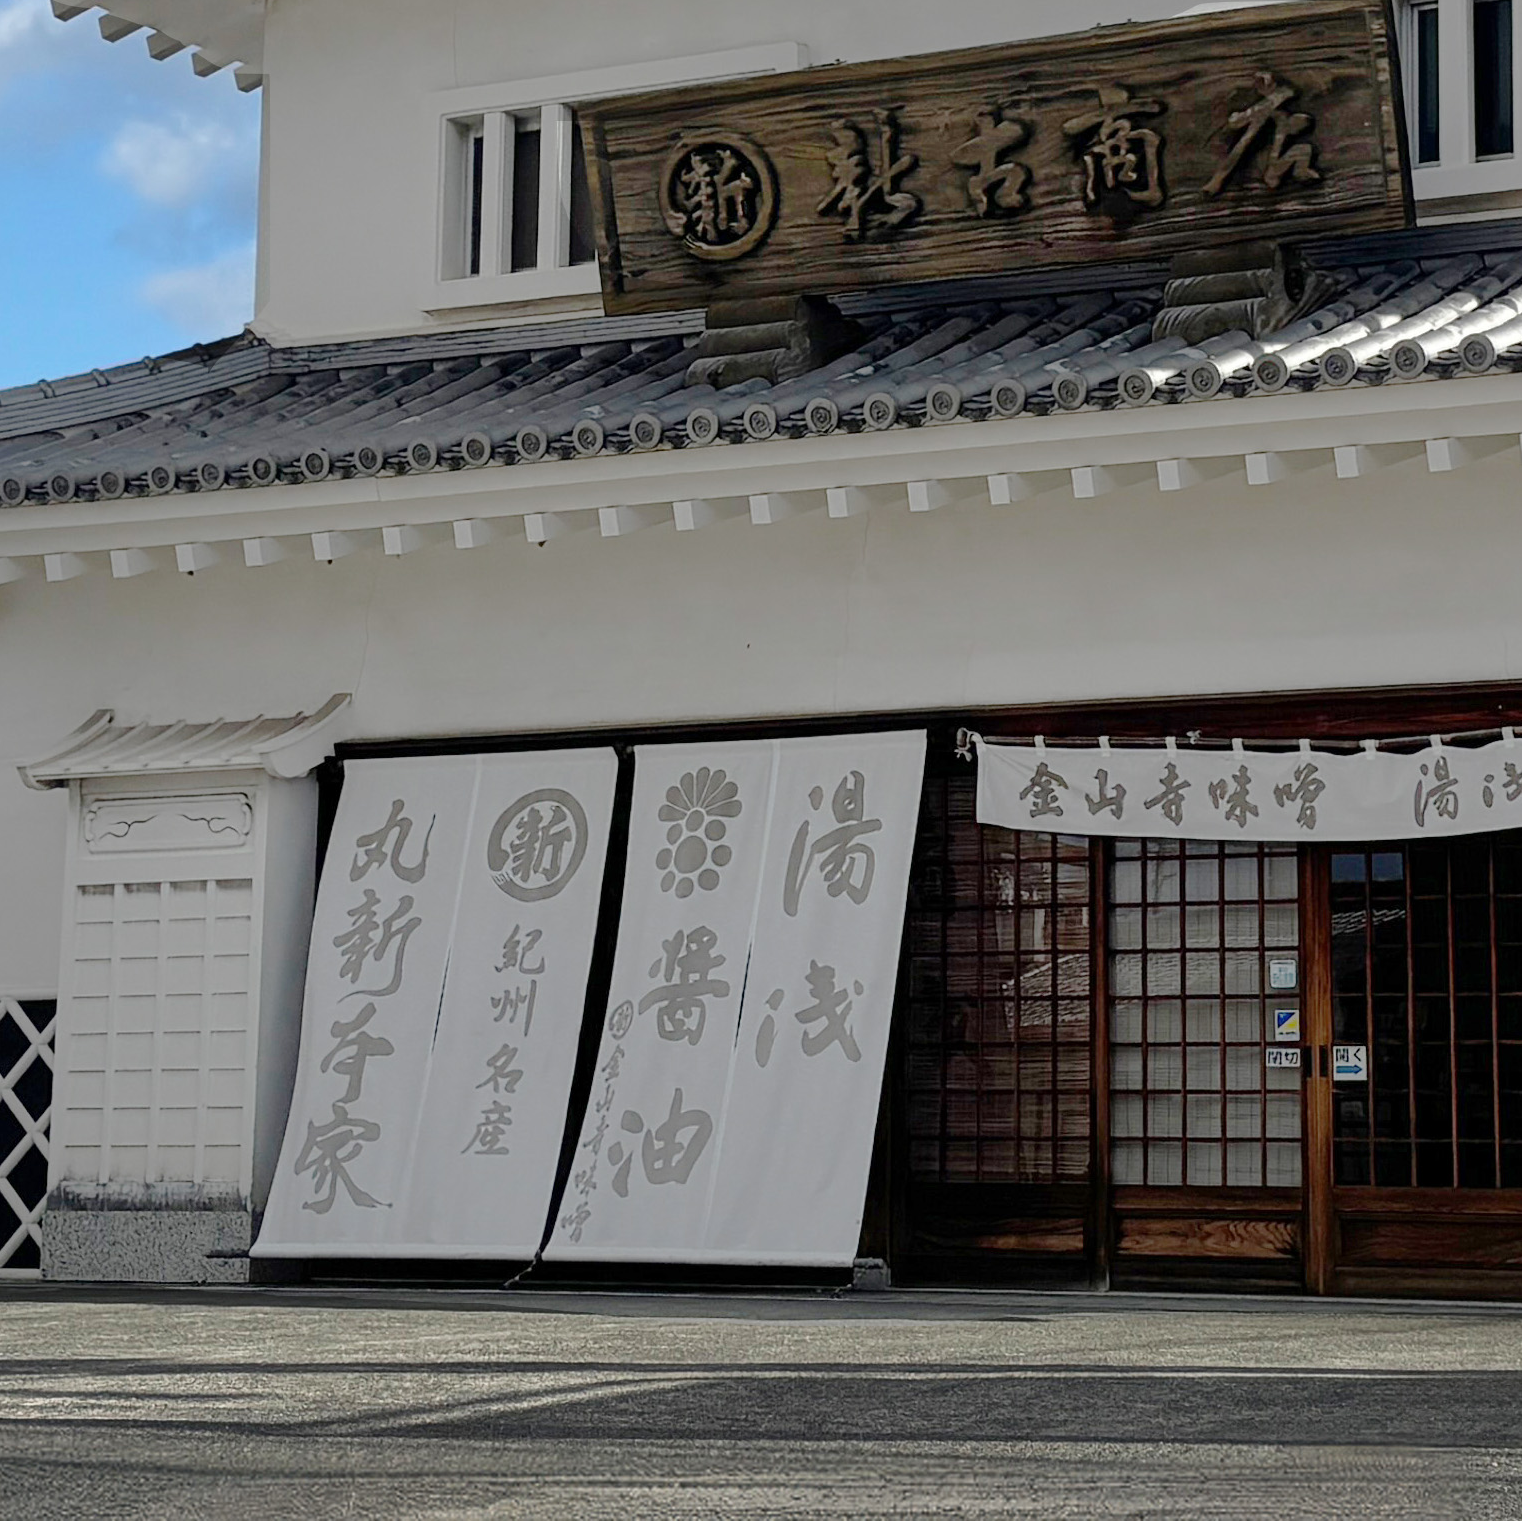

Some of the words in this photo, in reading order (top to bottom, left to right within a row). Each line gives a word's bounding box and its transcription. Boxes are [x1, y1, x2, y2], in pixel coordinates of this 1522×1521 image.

[754, 769, 883, 1069] 湯浅
[1020, 762, 1326, 831] 金山寺味噌
[460, 923, 546, 1156] 紀州名産
[606, 924, 731, 1199] 醤油
